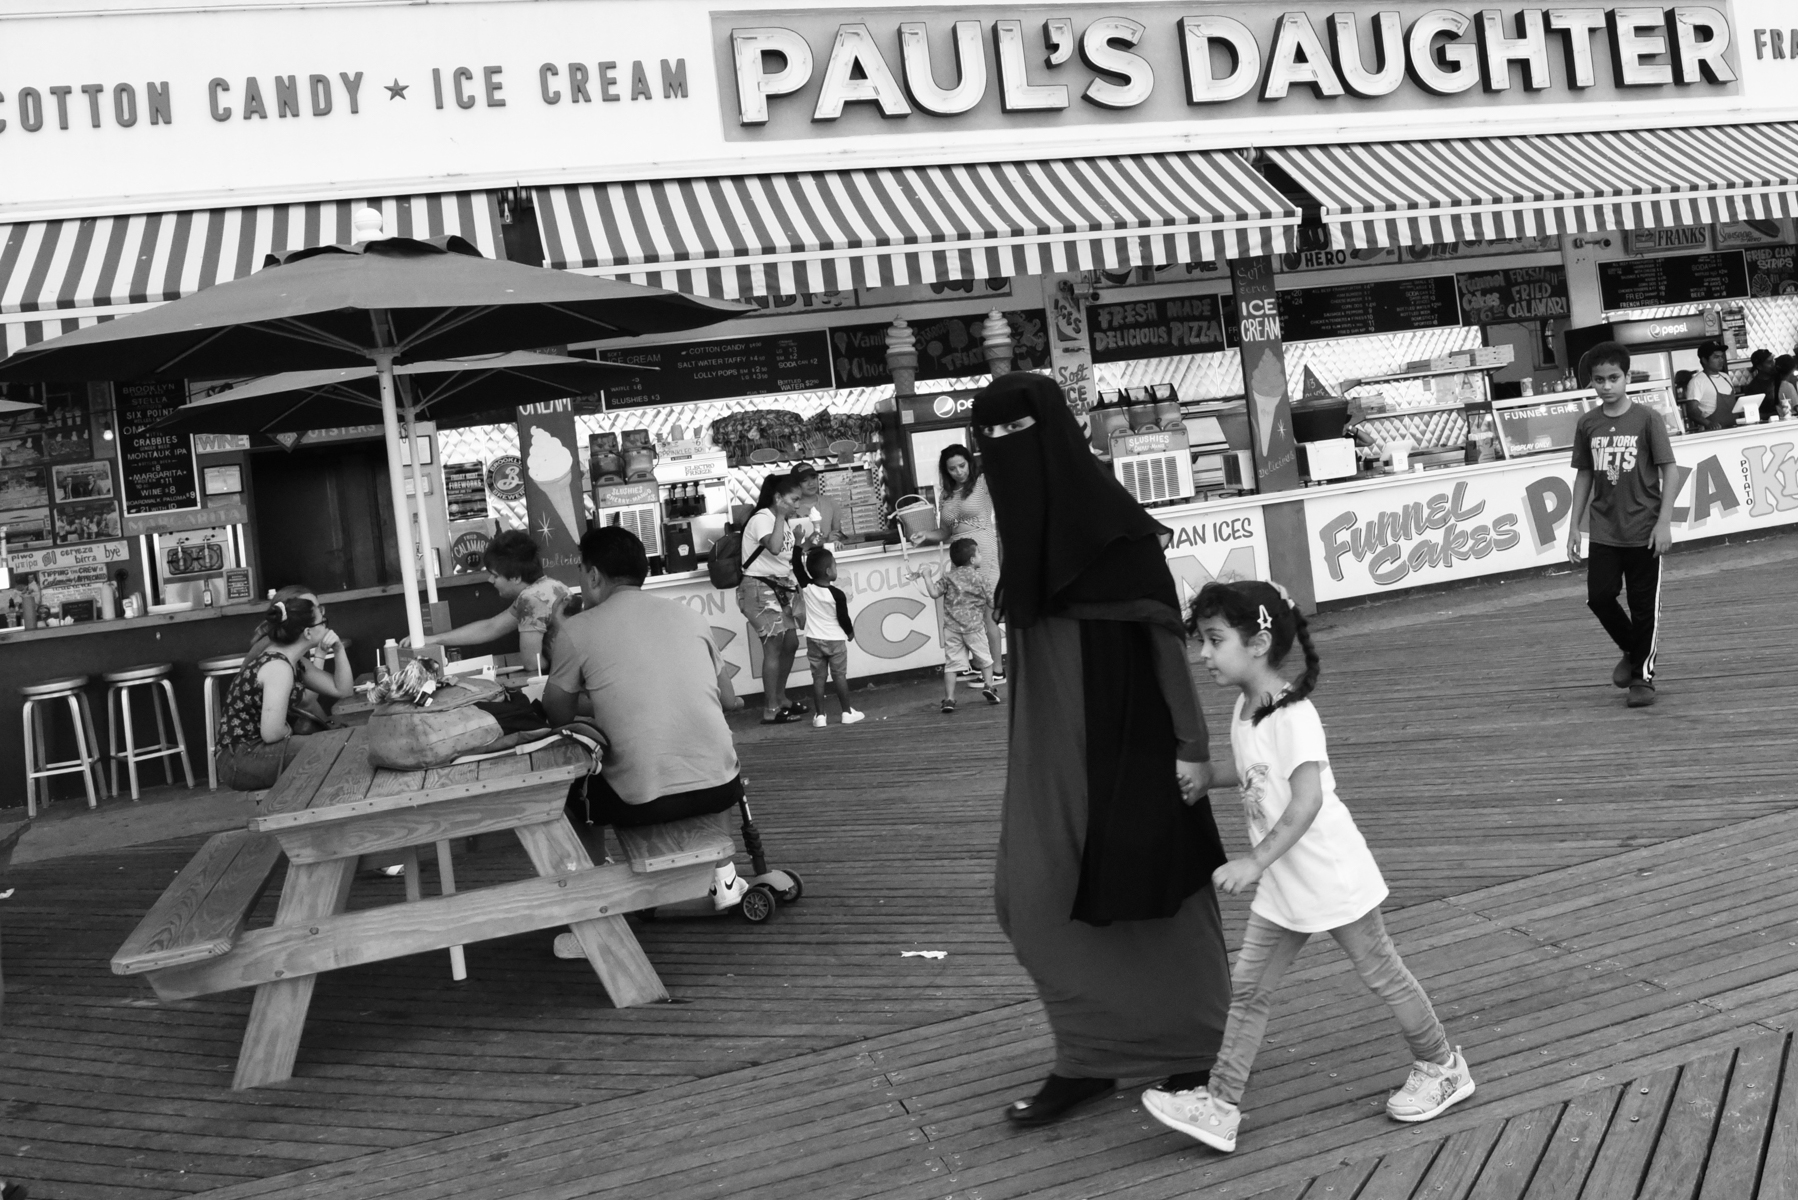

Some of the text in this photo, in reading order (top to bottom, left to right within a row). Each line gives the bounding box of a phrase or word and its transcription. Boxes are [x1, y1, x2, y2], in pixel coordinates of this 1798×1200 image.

[729, 7, 1739, 126] PAUL'S DAUGHTER
[432, 57, 690, 110] ICE CREAM
[0, 71, 364, 134] OTTON CANDY
[1657, 226, 1706, 247] FRANKS
[1304, 249, 1347, 268] HERO
[1745, 245, 1797, 263] FRIED CLAM
[1691, 263, 1710, 272] SODA
[1756, 257, 1795, 269] STRIPS
[1508, 265, 1546, 283] FRESH
[1510, 282, 1552, 302] FRIED
[1097, 297, 1213, 330] FRESH MADE
[1240, 298, 1278, 316] ICE
[1506, 296, 1568, 318] CALAMARI
[1240, 315, 1282, 342] CREAM
[1661, 321, 1688, 337] pepsi
[1092, 325, 1169, 353] DELICIOUS
[1169, 319, 1224, 348] PIZZA
[689, 343, 746, 355] COTTON CANDY
[626, 353, 662, 364] CREAM
[677, 355, 747, 369] SALT WATER TAFFY
[778, 361, 798, 369] SODA
[693, 370, 717, 380] LOLLY
[717, 368, 738, 377] POPS
[122, 383, 176, 396] BROOKLYN
[780, 383, 805, 391] WATER
[131, 396, 168, 406] STELLA
[611, 394, 649, 405] SLUSHIES
[1631, 393, 1661, 404] SLICE
[126, 407, 175, 421] SIX POINT
[1504, 406, 1548, 421] FUNNEL
[133, 435, 179, 448] CRABBIES
[197, 433, 250, 451] WINE
[1128, 434, 1170, 447] SLUSHIES
[1510, 441, 1551, 452] DISPLAY ONLY
[1591, 435, 1639, 449] NEW YORK
[127, 447, 189, 461] MONTAUK IPA
[1591, 446, 1638, 471] METS
[685, 463, 715, 471] ELECTRO
[685, 468, 713, 477] FREEZE
[132, 469, 183, 482] MARGARITA
[1740, 459, 1754, 506] POTATO
[140, 487, 163, 497] WINE
[611, 485, 644, 496] SLUSHIES
[162, 495, 187, 503] PALOMA
[140, 502, 178, 513] 21 WITH ID
[127, 508, 242, 533] MARGARITA
[1213, 516, 1254, 543] ICES
[11, 553, 34, 562] piwo
[60, 547, 94, 557] cerveza
[74, 554, 97, 565] birra
[41, 569, 70, 579] TIPPING
[78, 565, 99, 574] CREW
